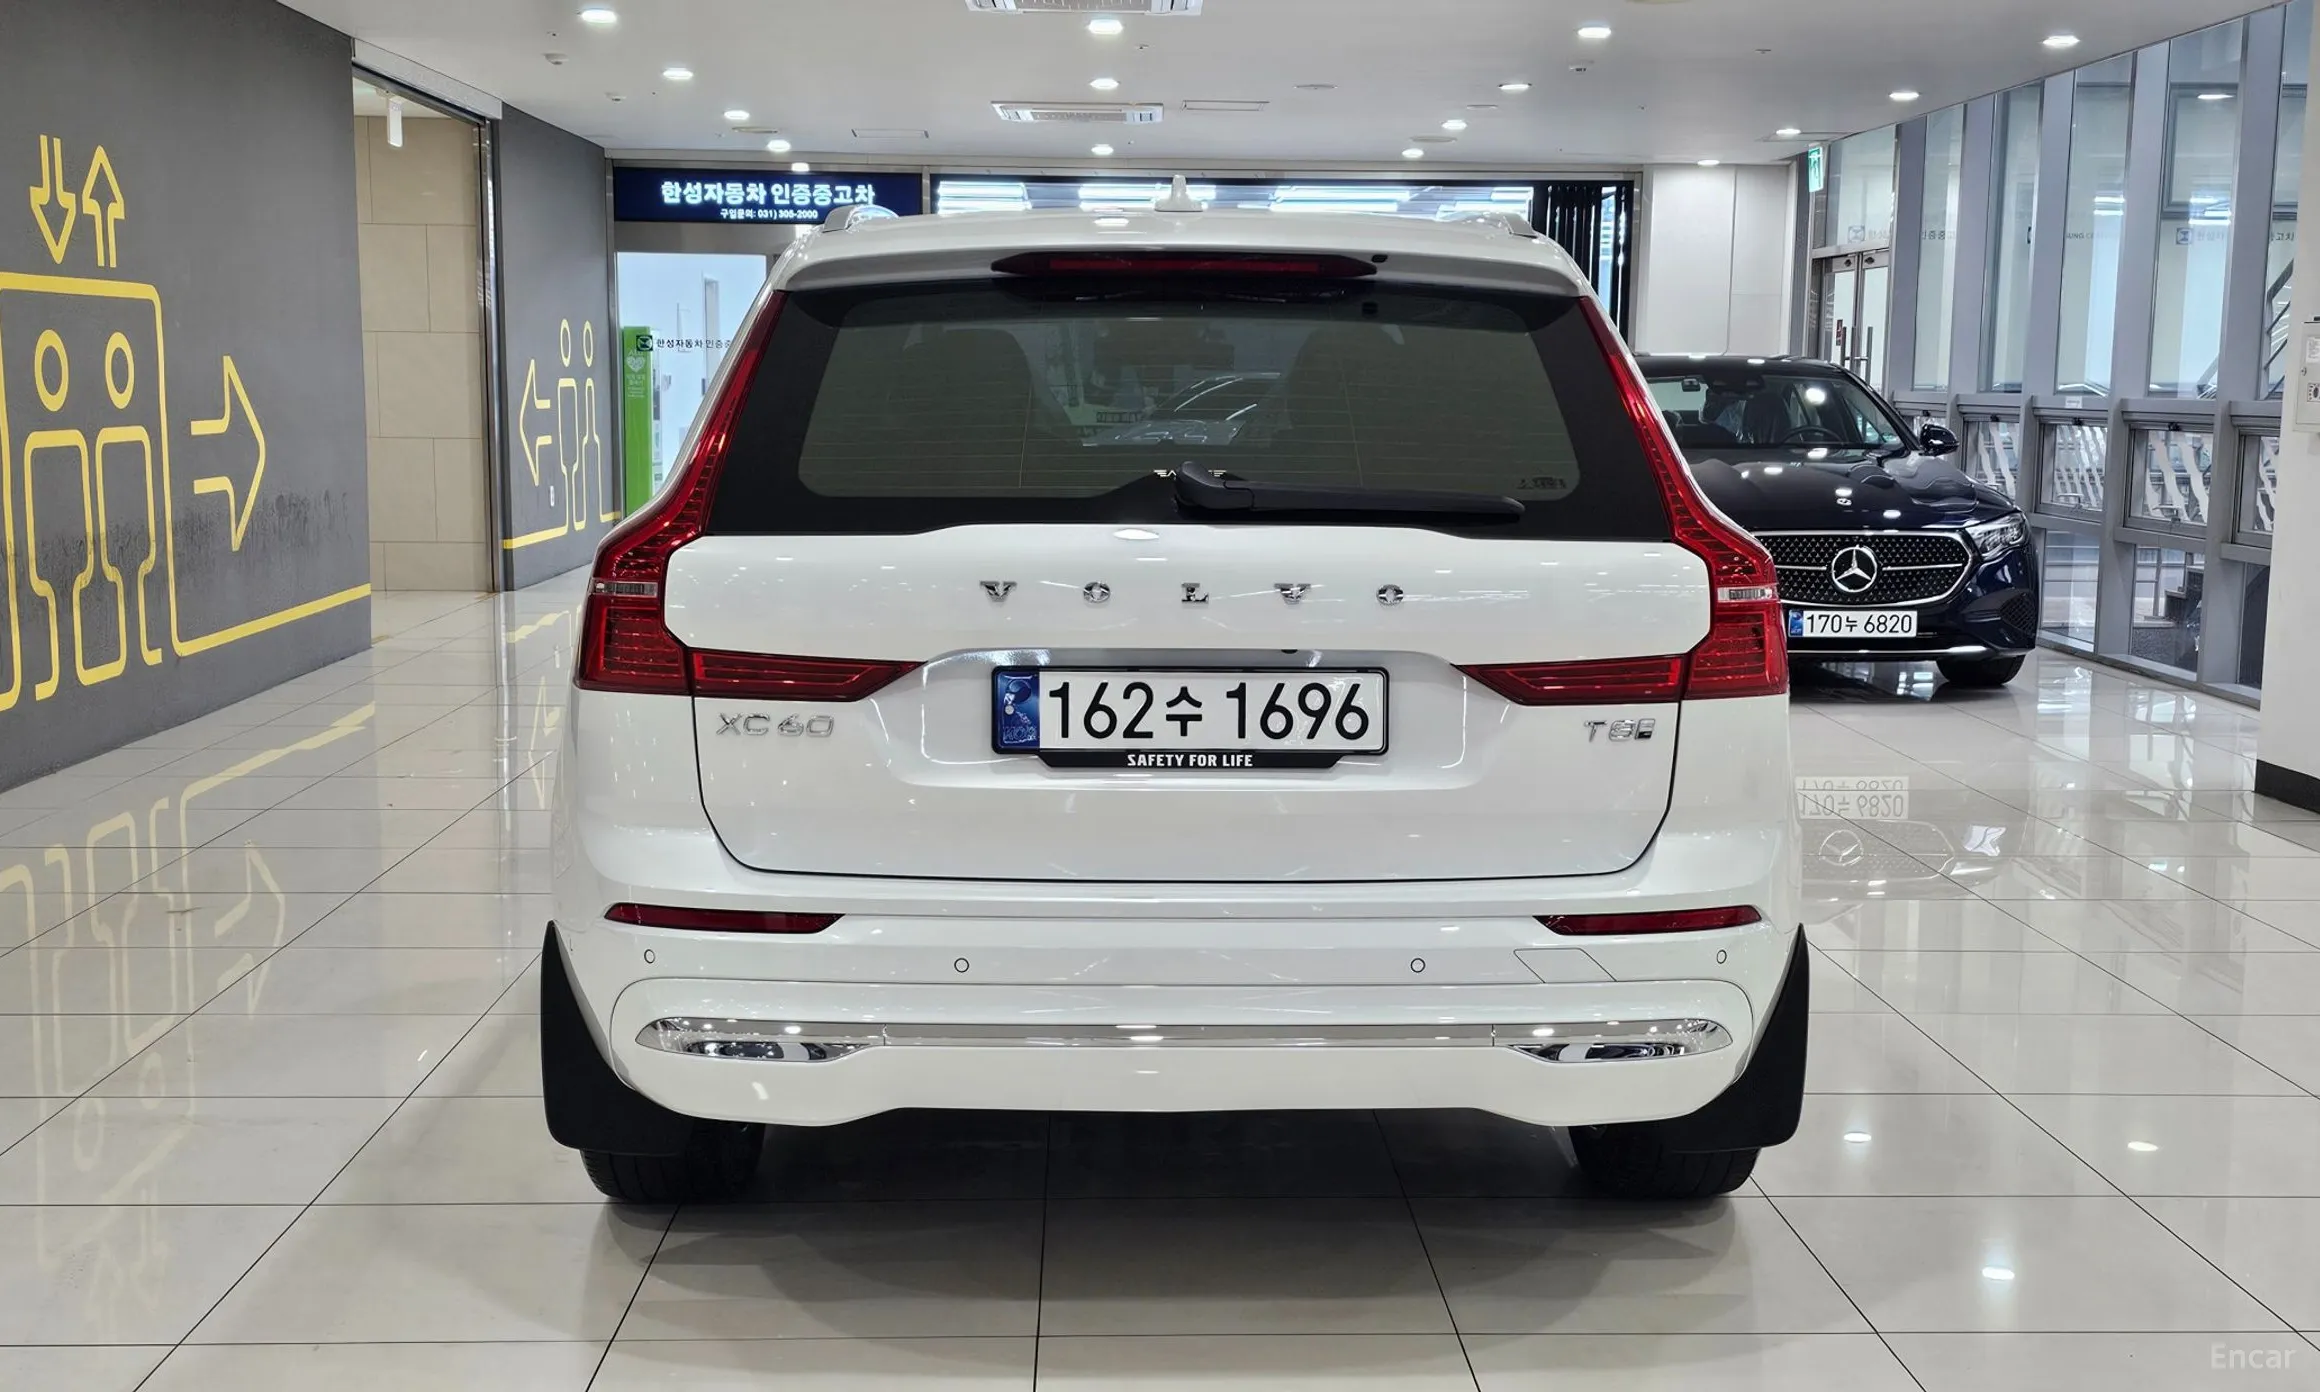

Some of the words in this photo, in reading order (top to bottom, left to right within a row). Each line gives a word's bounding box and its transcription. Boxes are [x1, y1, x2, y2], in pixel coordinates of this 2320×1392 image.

[661, 181, 767, 205] 한성자동차
[770, 183, 876, 207] 인증중고차
[656, 339, 702, 349] 한성자동차
[980, 581, 1404, 606] VOLVO
[1807, 614, 1858, 633] 170누
[1863, 614, 1912, 633] 6820
[1049, 682, 1203, 739] 162수
[1226, 682, 1370, 740] 1696
[1127, 754, 1185, 768] SAFETY
[1189, 754, 1218, 768] FOR
[1223, 754, 1254, 768] LIFE
